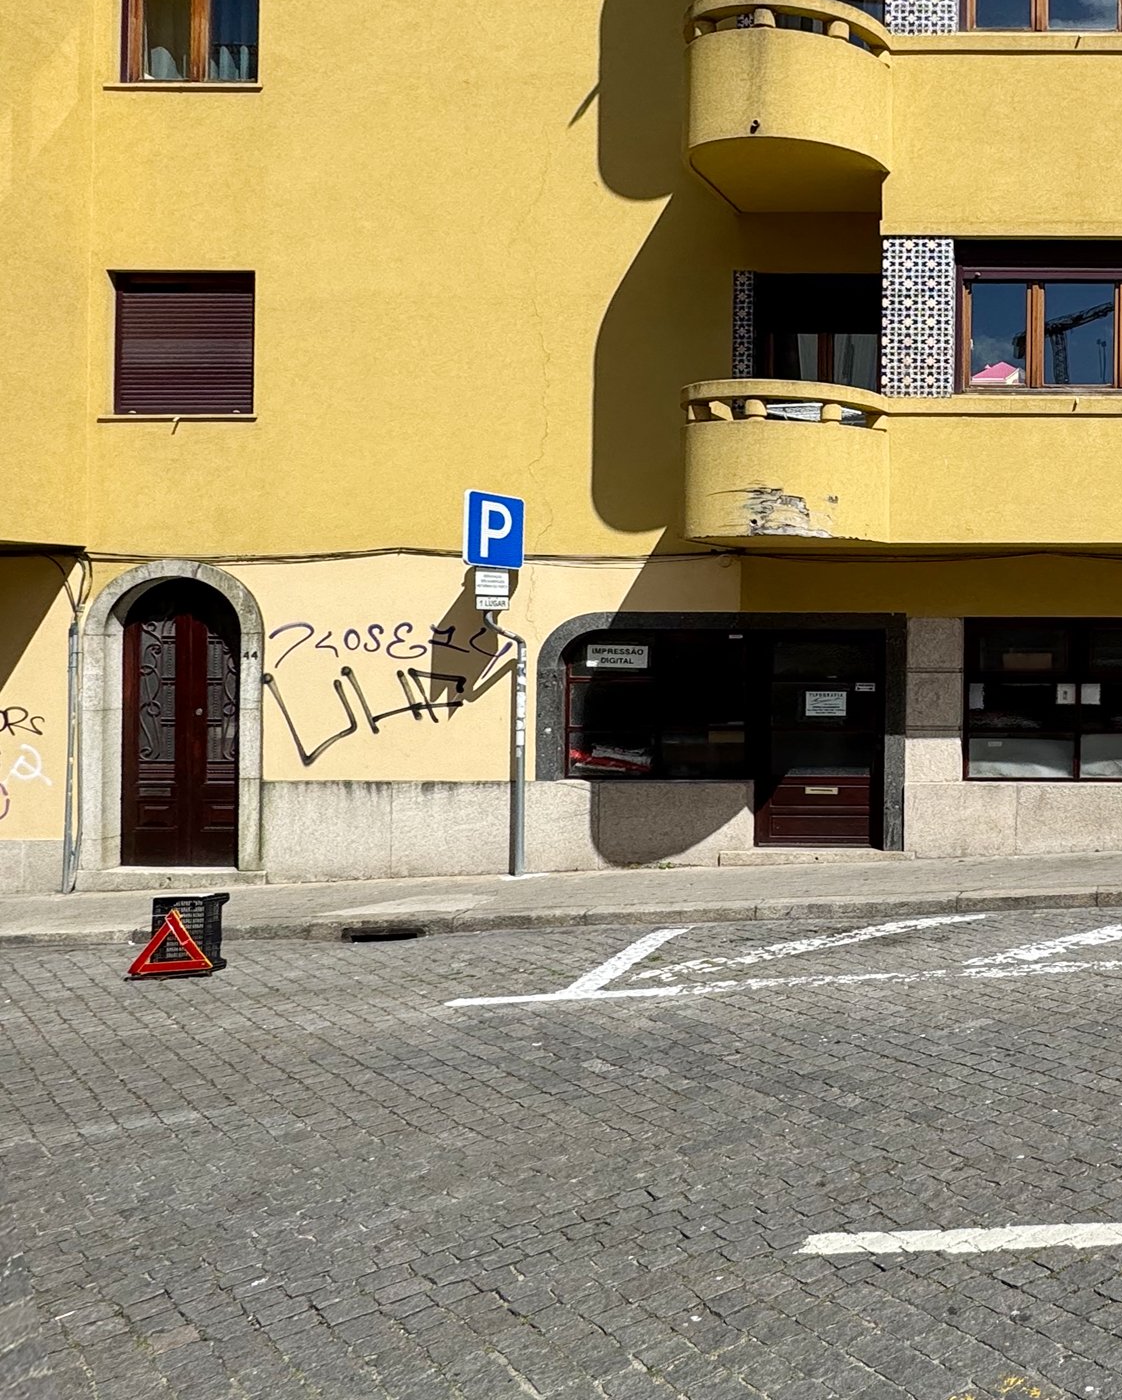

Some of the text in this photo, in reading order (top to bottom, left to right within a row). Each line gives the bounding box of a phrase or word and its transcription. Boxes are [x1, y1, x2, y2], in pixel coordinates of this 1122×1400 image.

[480, 500, 512, 558] P
[484, 599, 506, 608] LUGAR
[242, 651, 259, 661] 44
[591, 647, 644, 656] IMPRESSÃO
[600, 657, 634, 665] DIGITAL
